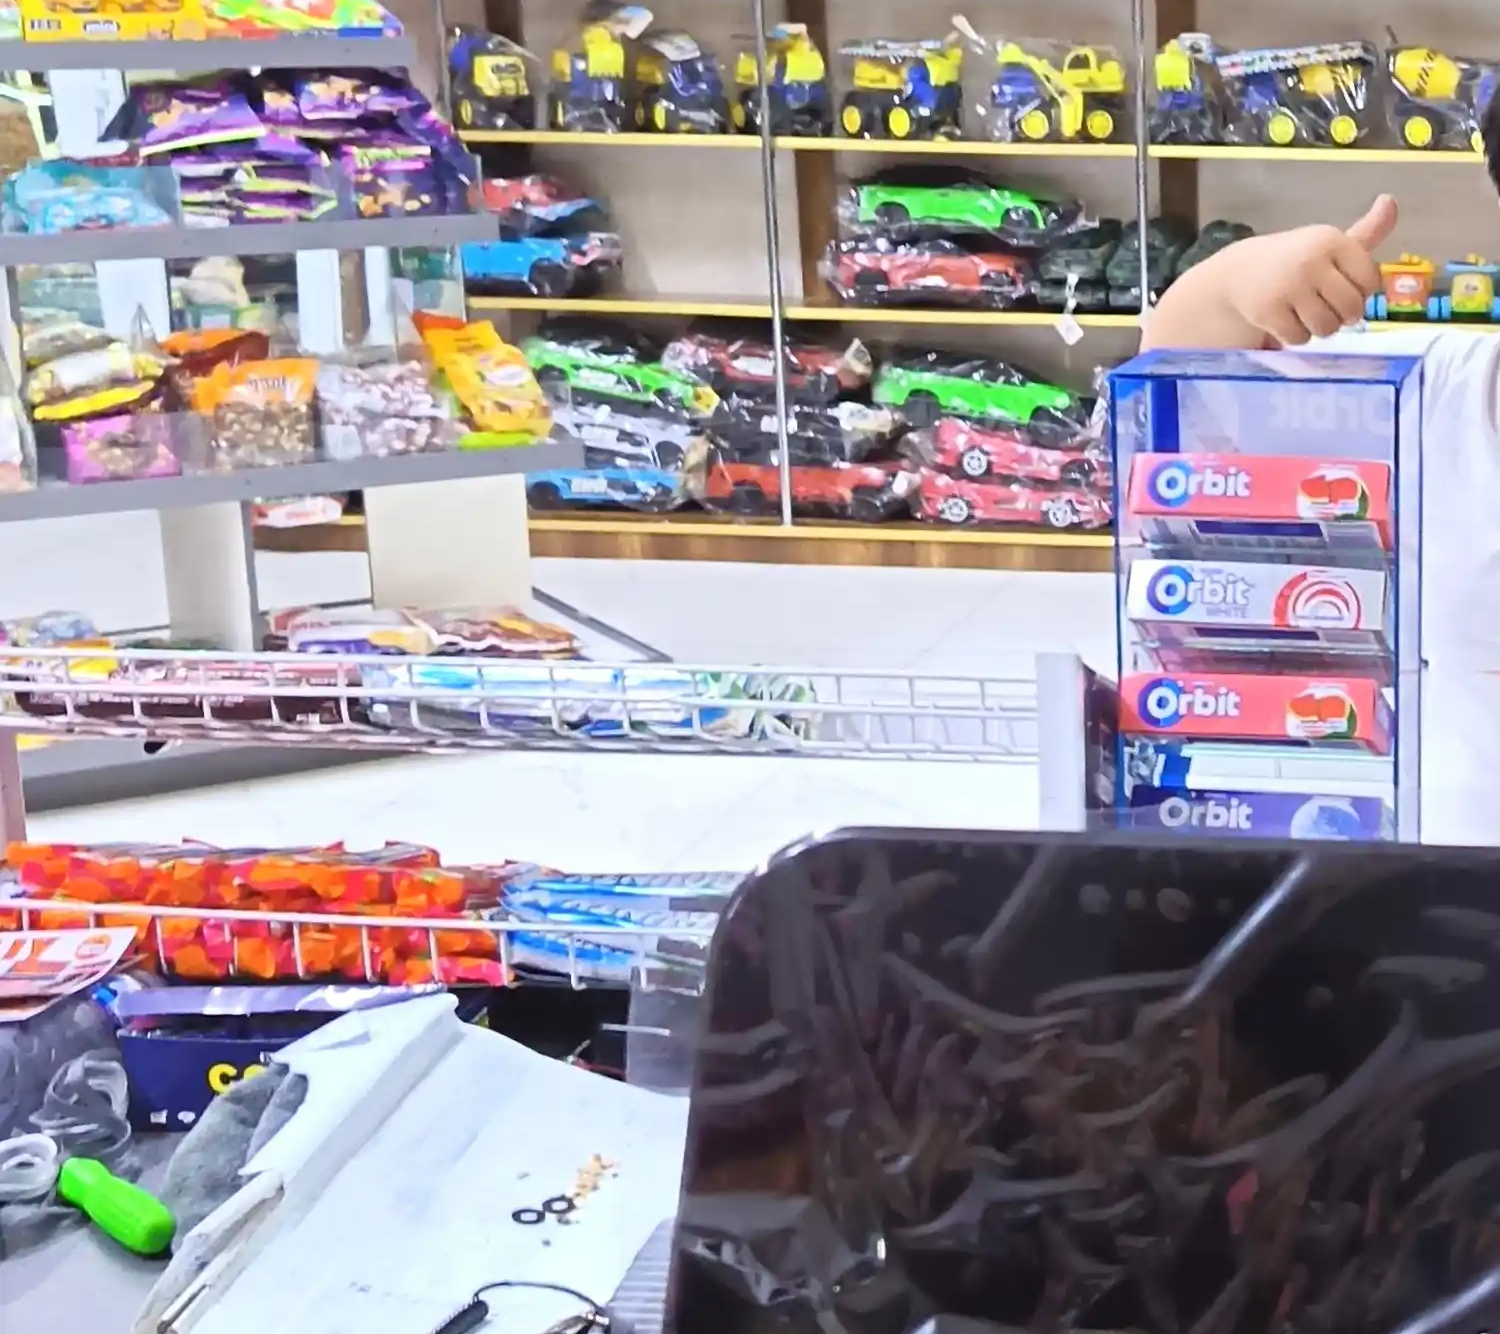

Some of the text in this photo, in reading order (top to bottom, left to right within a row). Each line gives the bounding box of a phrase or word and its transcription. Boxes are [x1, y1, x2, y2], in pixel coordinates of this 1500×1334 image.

[1156, 466, 1252, 500] Orbit
[1155, 572, 1252, 607] Orbit
[1147, 686, 1242, 719] Orbit
[1159, 797, 1254, 830] Orbit
